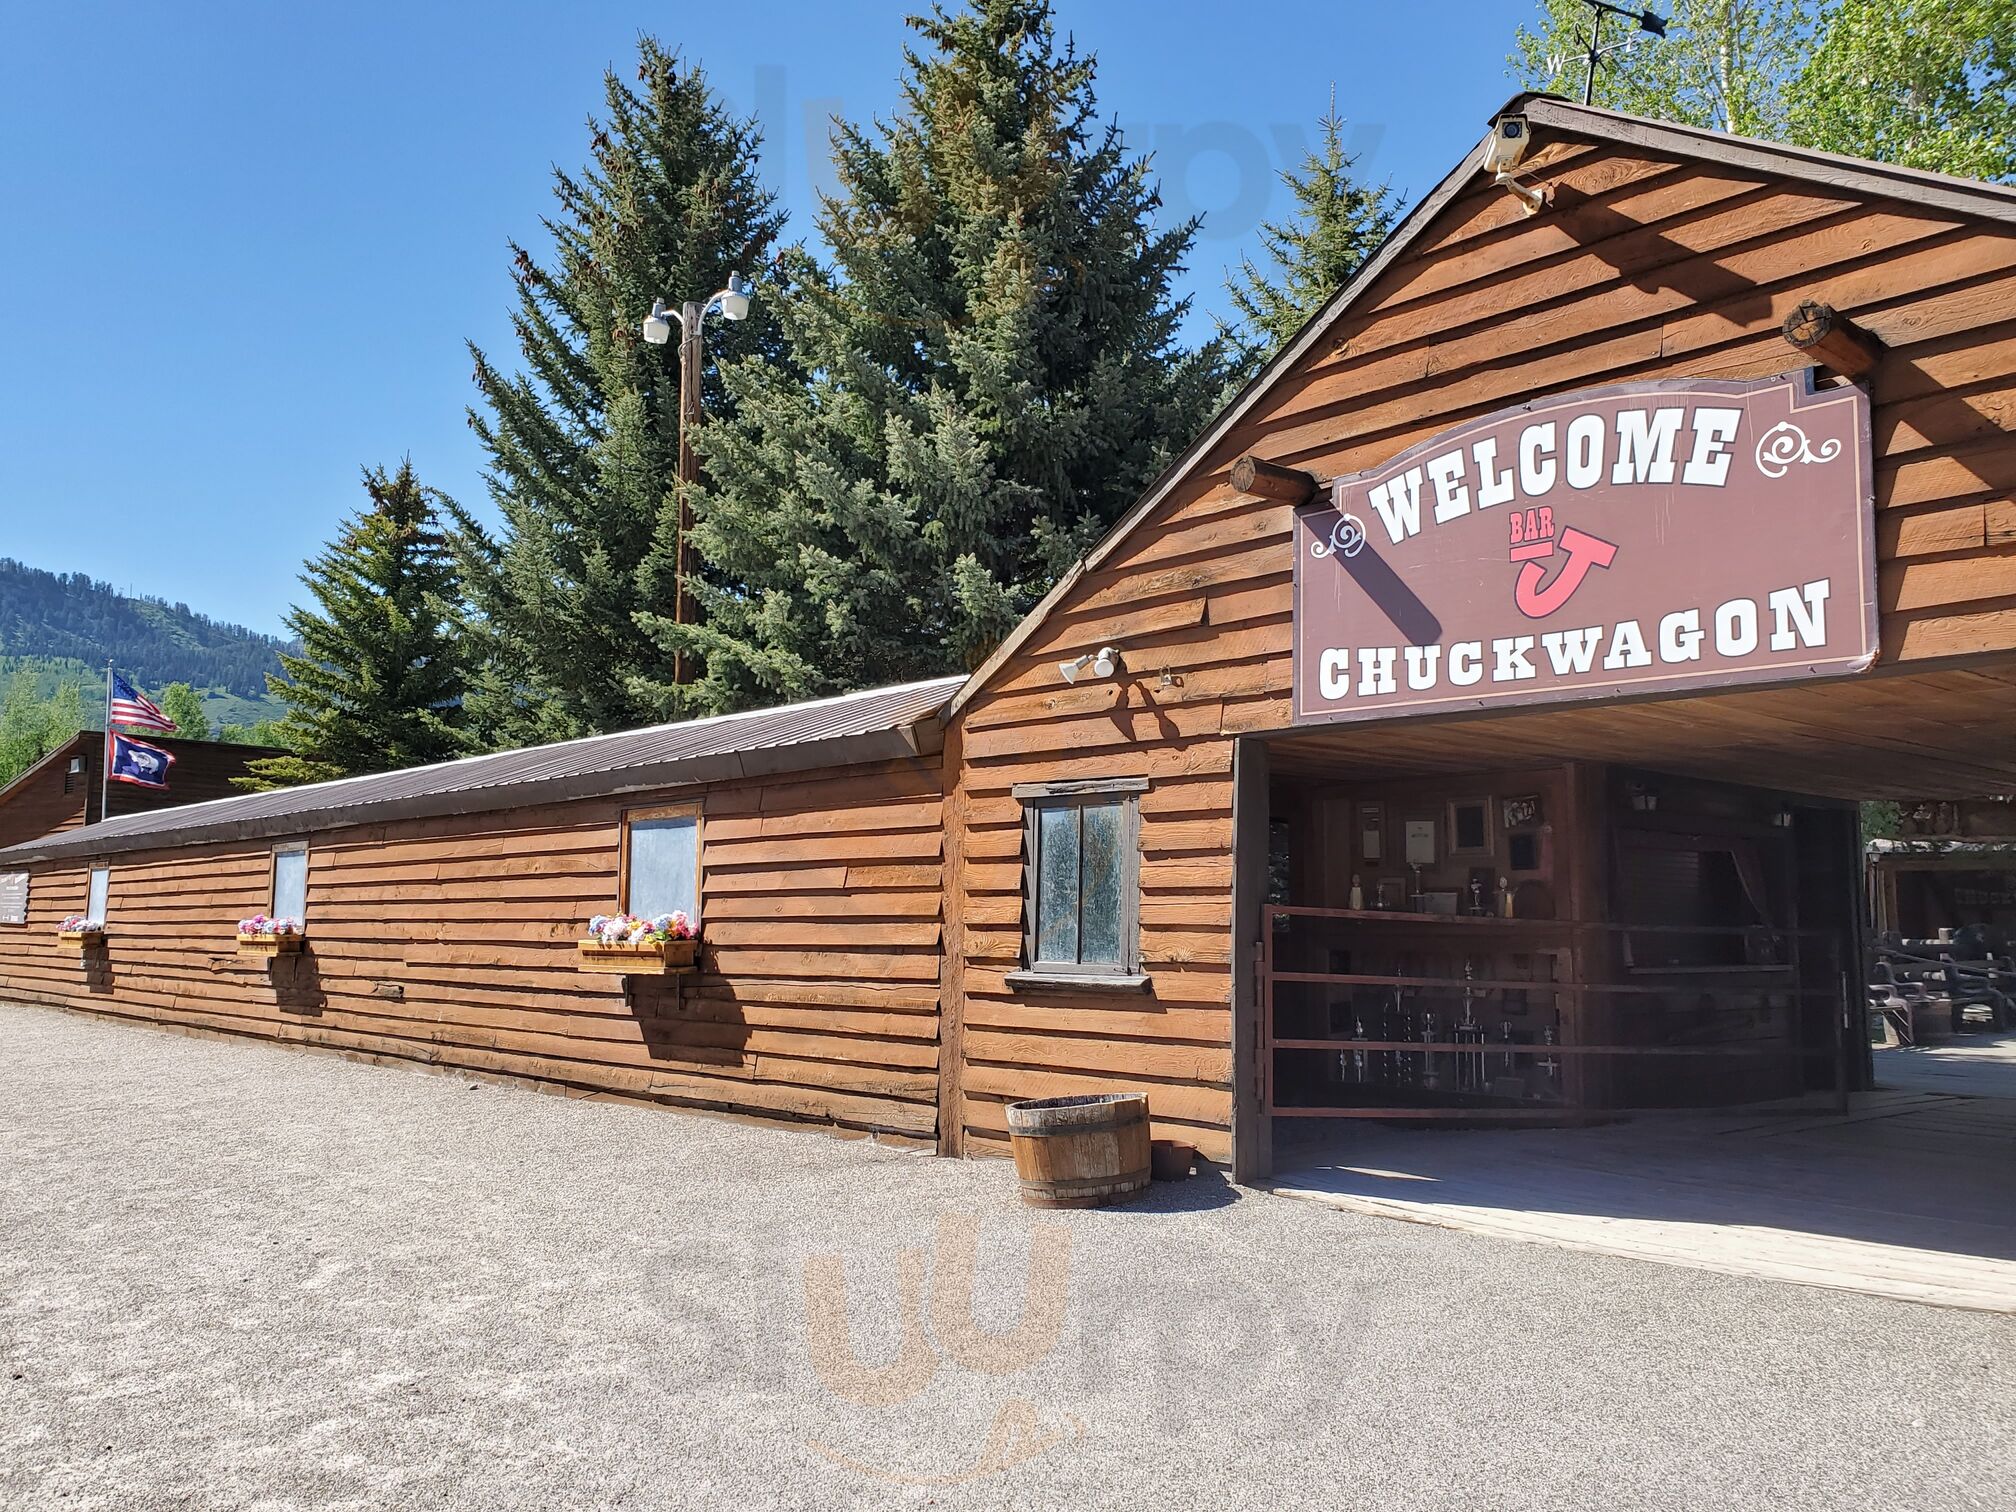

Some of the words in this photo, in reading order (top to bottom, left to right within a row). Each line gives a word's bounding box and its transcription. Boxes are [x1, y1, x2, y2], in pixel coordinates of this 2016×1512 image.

[1367, 407, 1743, 545] WELCOME
[1509, 506, 1555, 544] BAR
[1319, 578, 1830, 700] CHUCKWAGON
